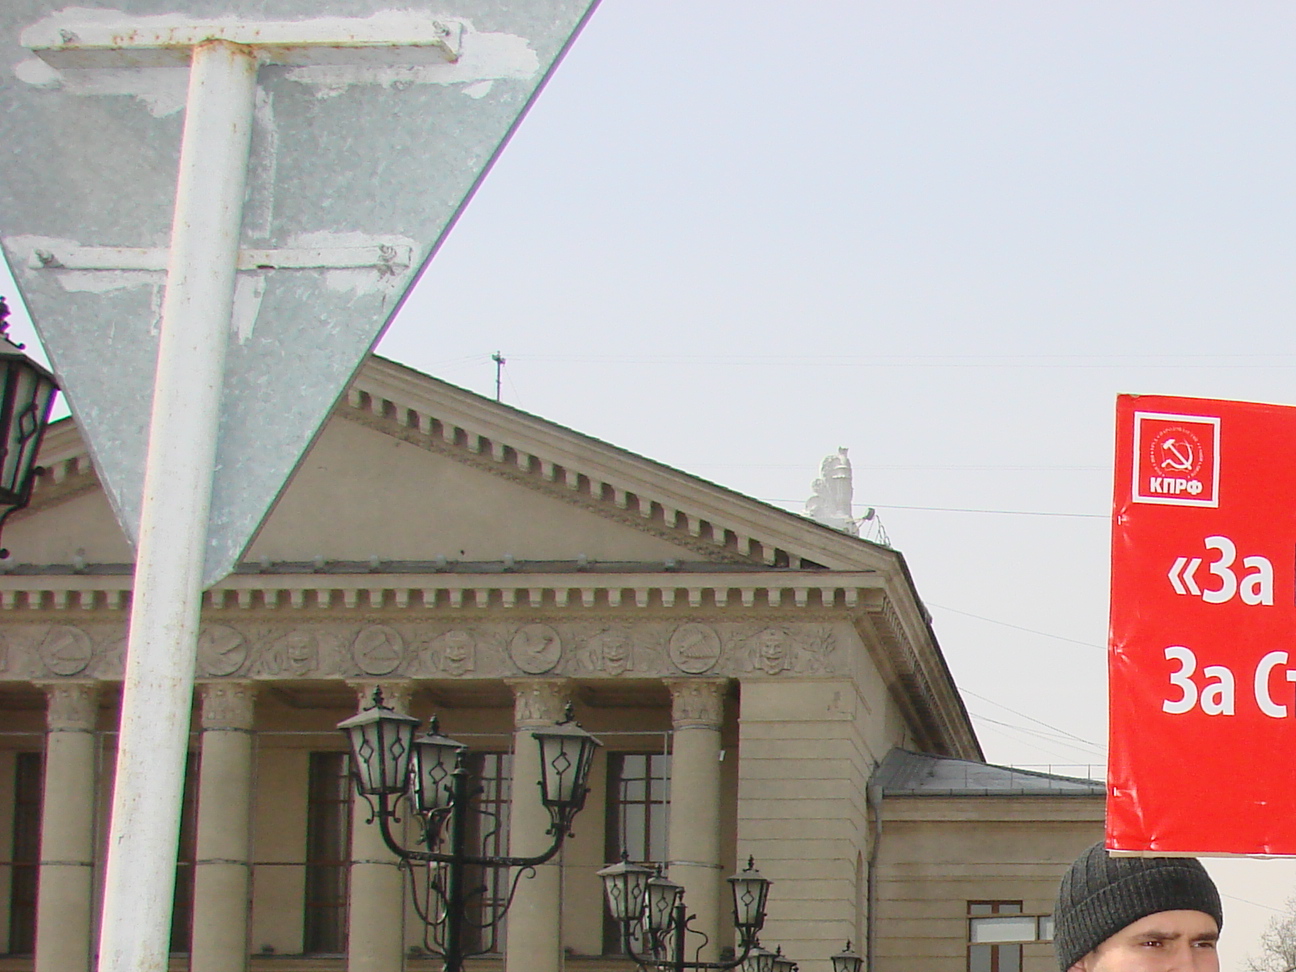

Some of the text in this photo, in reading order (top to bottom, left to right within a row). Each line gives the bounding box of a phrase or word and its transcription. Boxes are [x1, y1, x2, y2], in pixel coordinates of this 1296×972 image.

[1150, 476, 1203, 496] КПРФ
[1167, 535, 1275, 606] «За
[1162, 645, 1236, 716] За
